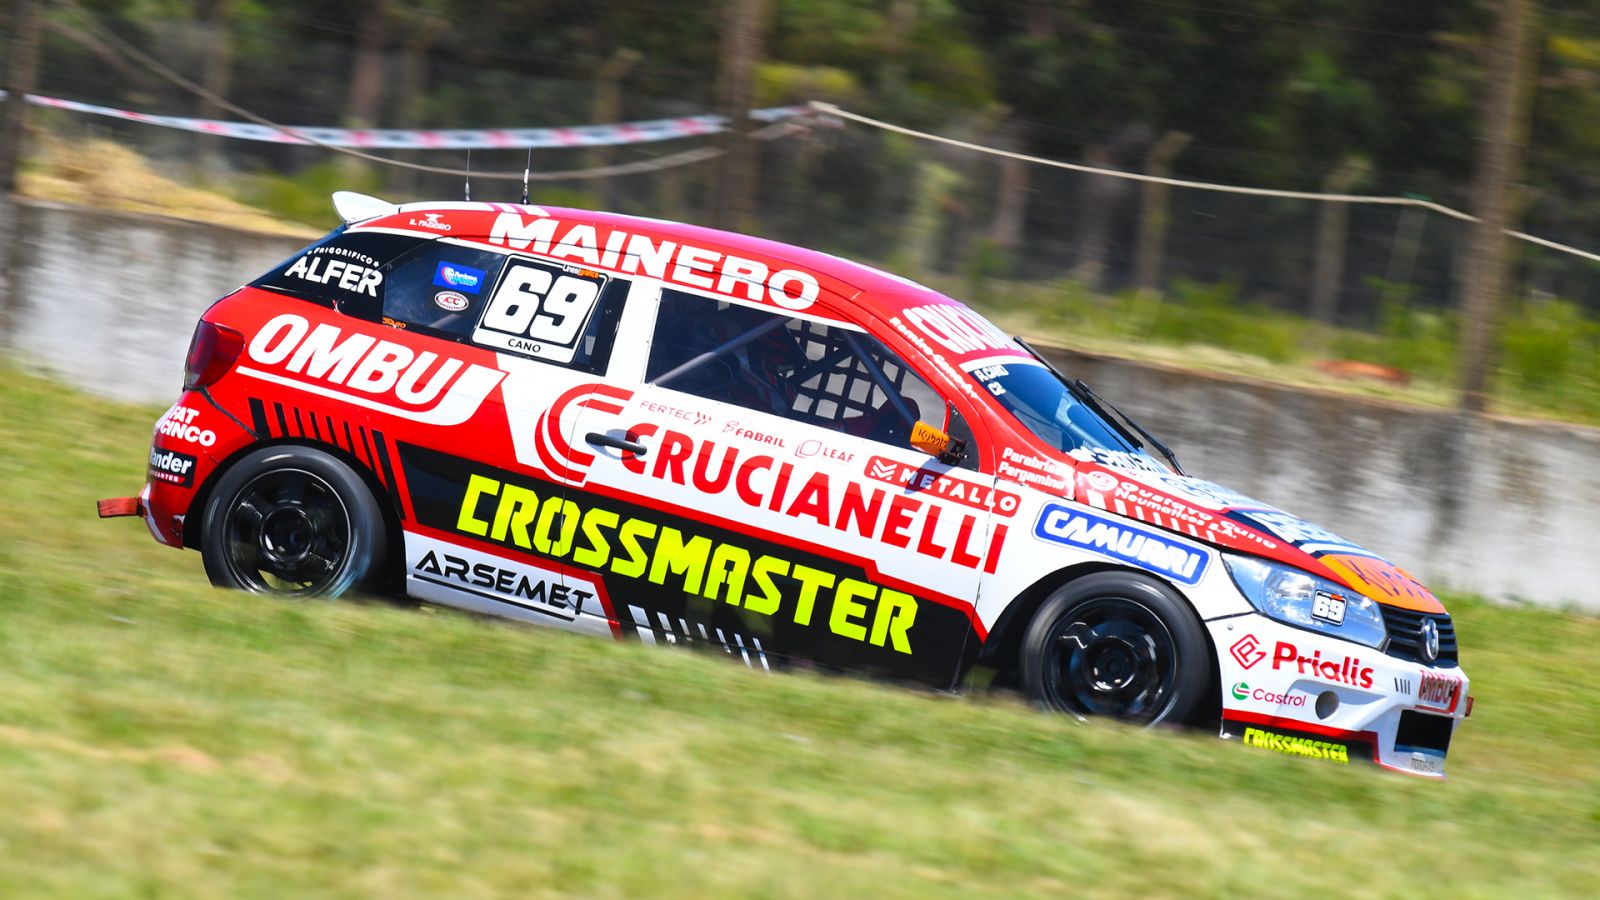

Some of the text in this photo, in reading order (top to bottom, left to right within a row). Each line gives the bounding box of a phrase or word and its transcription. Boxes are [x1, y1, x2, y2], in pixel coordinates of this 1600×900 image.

[313, 247, 373, 265] FRIGORIFICO
[489, 213, 820, 310] MAINERO
[284, 256, 383, 298] ALFER
[483, 264, 598, 345] 69
[248, 314, 463, 405] OMBU
[508, 338, 541, 353] CANO
[640, 401, 692, 421] FERTEC
[160, 419, 216, 447] CINCO
[736, 428, 785, 448] FABRIL
[823, 447, 855, 463] LEAF
[900, 468, 1016, 511] METALLO
[998, 461, 1065, 490] Pergamino
[621, 422, 1009, 575] CRUCIANELLI
[457, 474, 918, 655] CROSSMASTER
[414, 550, 593, 616] ARSEMET
[1312, 594, 1346, 622] 69
[1272, 641, 1374, 689] Prialis
[1252, 688, 1307, 708] Castrol
